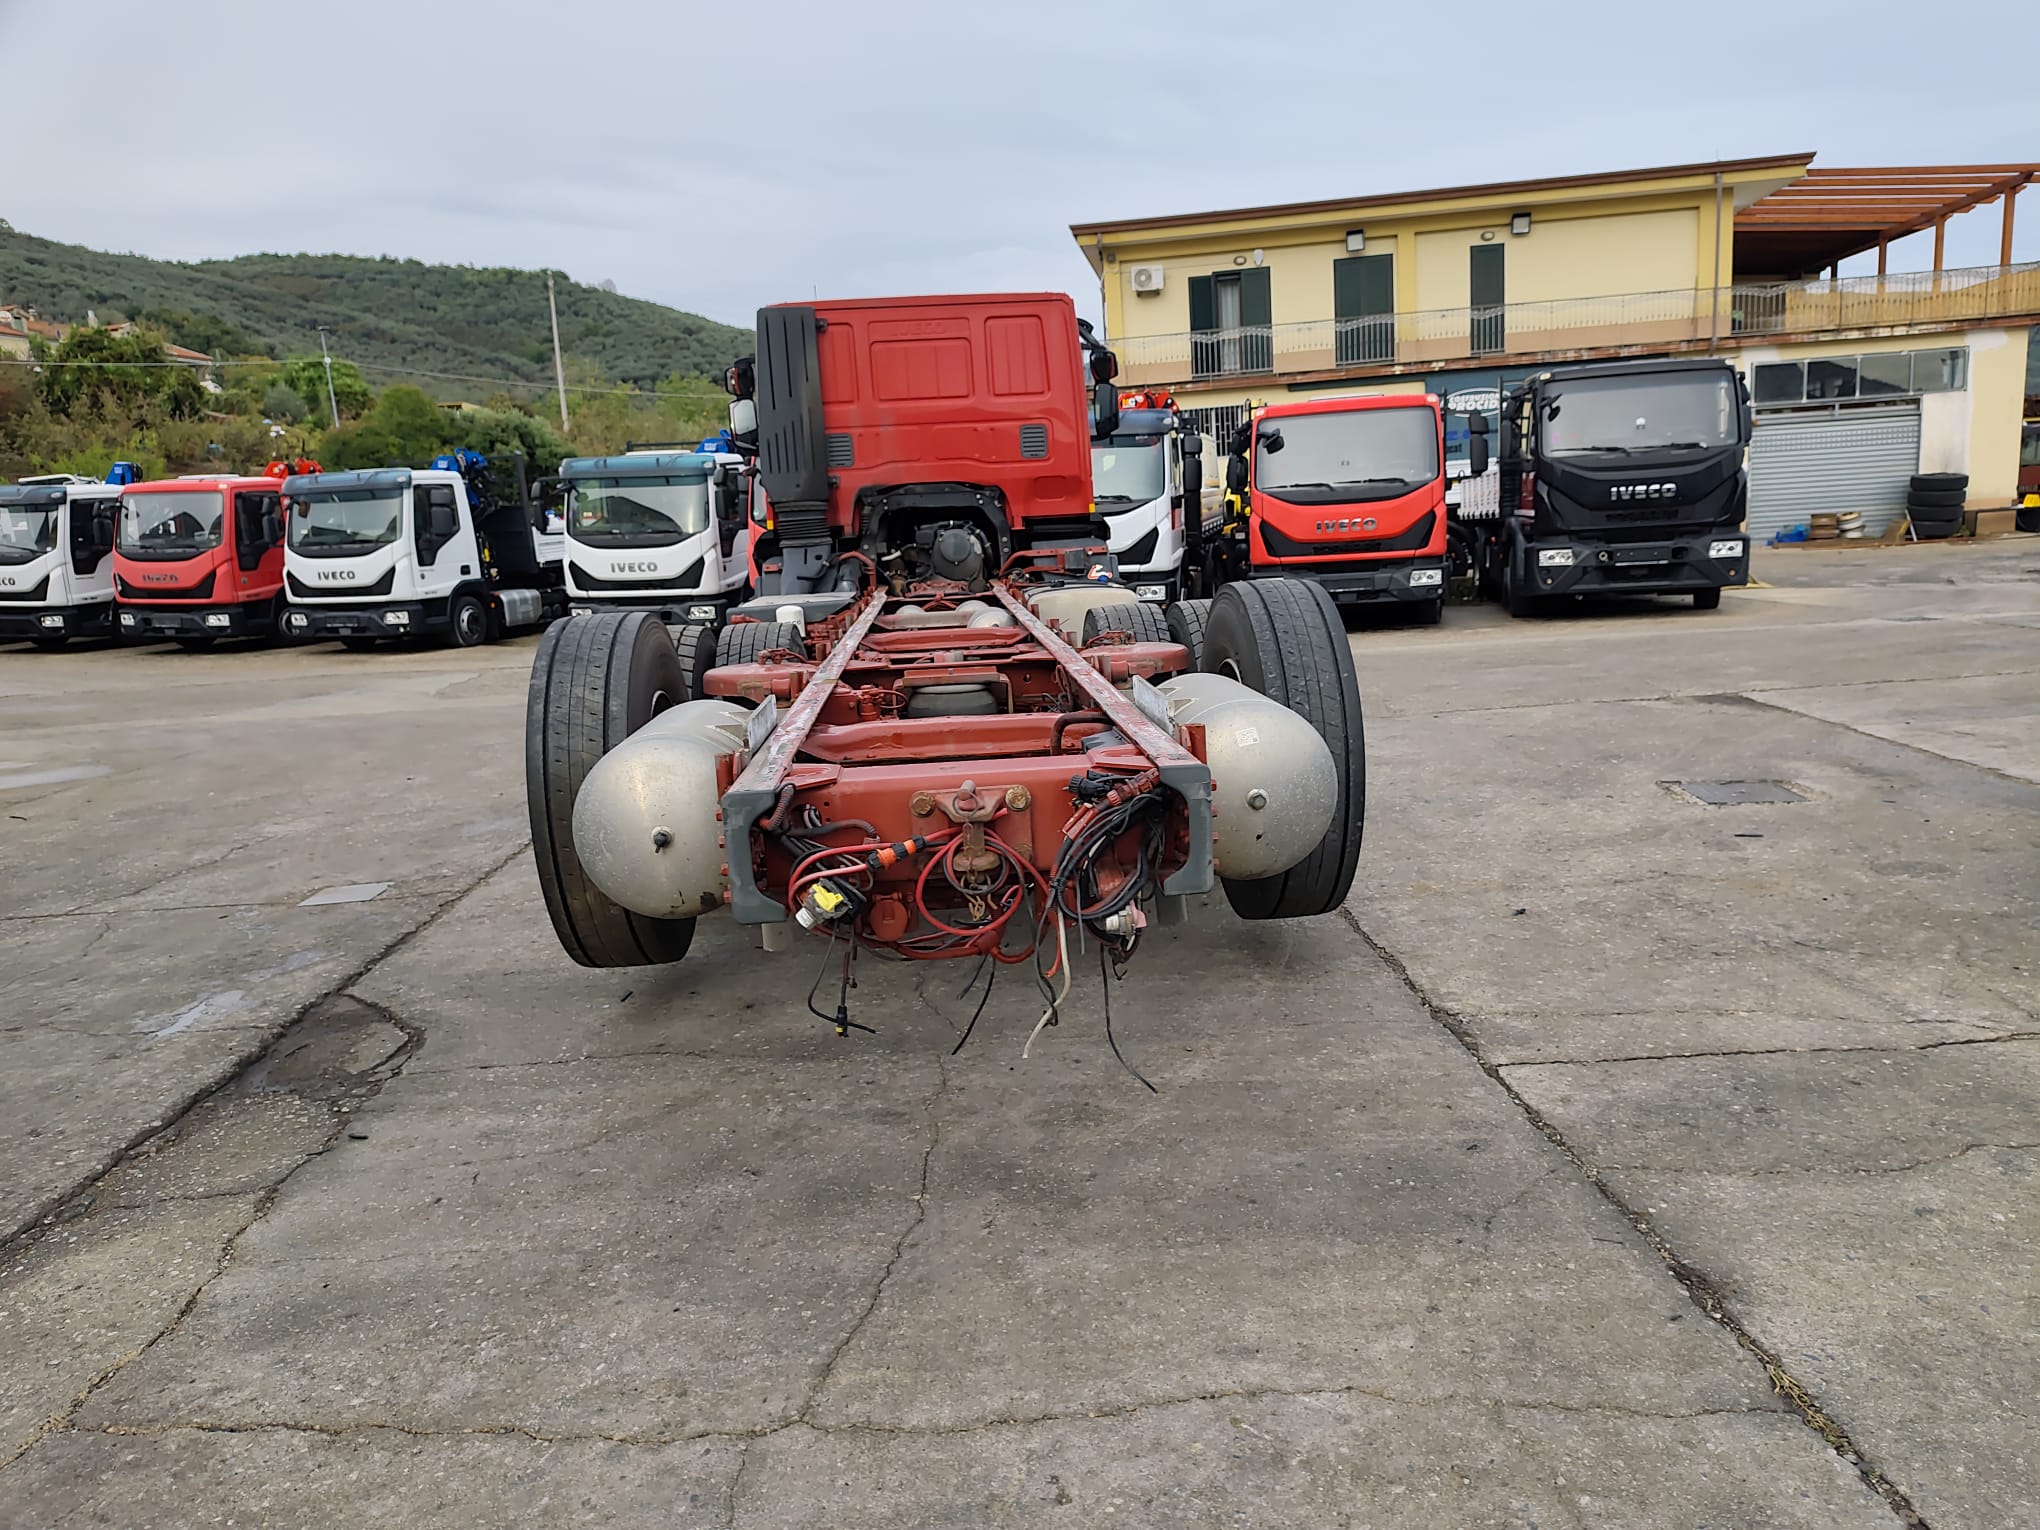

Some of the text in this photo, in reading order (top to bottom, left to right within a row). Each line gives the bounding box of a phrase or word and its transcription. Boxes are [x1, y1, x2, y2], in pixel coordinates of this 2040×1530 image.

[1610, 482, 1677, 501] IVECO
[1315, 517, 1377, 534] IVECO
[610, 561, 658, 573] IVECO
[317, 570, 356, 580] IVECO
